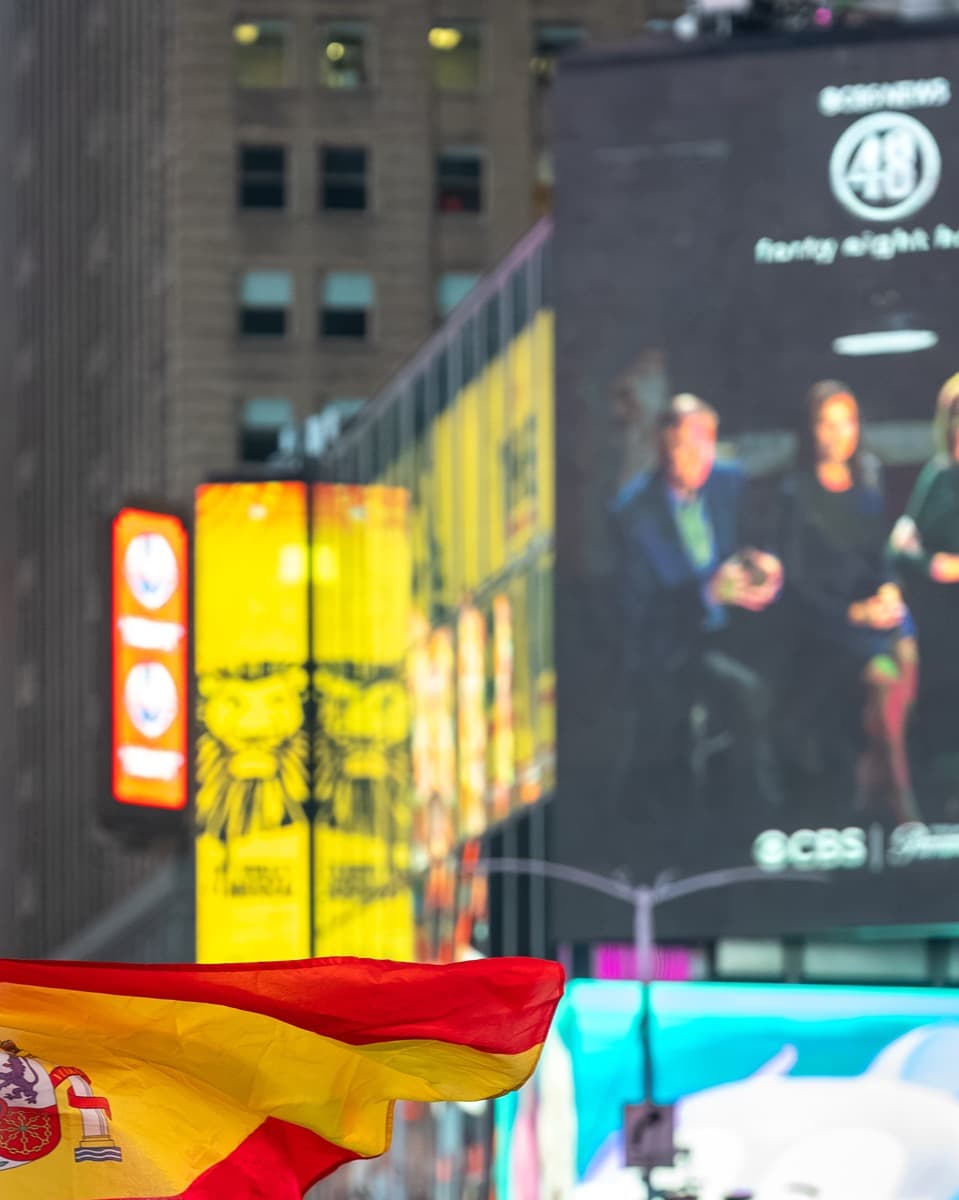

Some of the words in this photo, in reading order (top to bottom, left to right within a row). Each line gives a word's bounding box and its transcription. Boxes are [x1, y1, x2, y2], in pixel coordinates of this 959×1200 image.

[845, 127, 917, 200] 48
[841, 228, 930, 260] eight
[788, 827, 867, 870] CBS
